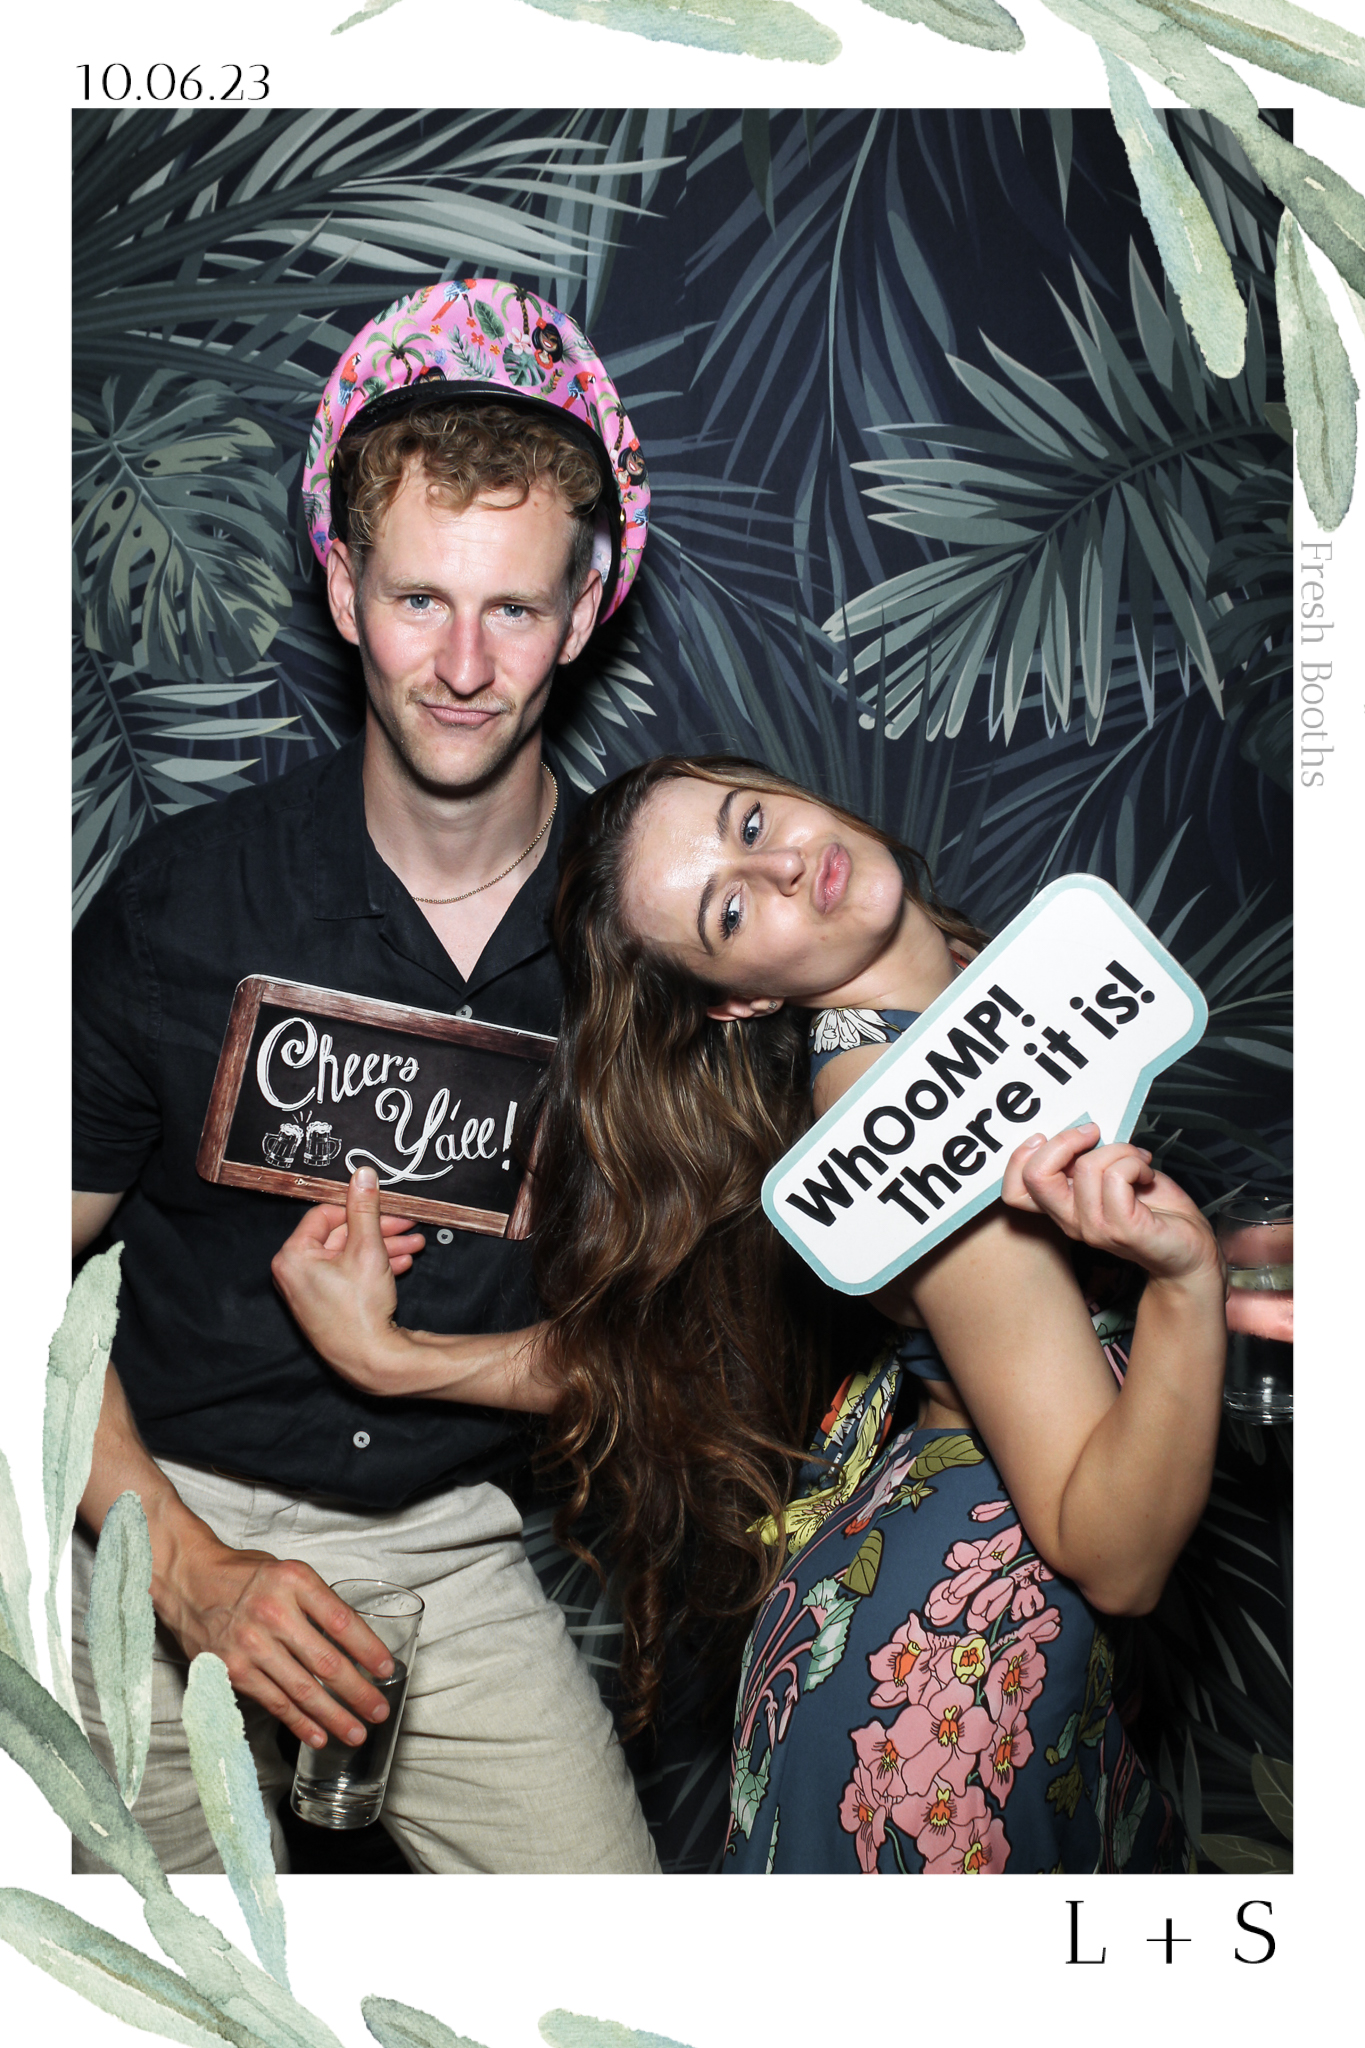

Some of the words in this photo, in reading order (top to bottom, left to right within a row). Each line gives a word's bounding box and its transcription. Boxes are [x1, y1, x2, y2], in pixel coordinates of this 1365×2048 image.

[256, 1017, 419, 1112] Cheers
[877, 1081, 1042, 1225] There
[1023, 1026, 1089, 1085] it
[1070, 960, 1155, 1039] is!
